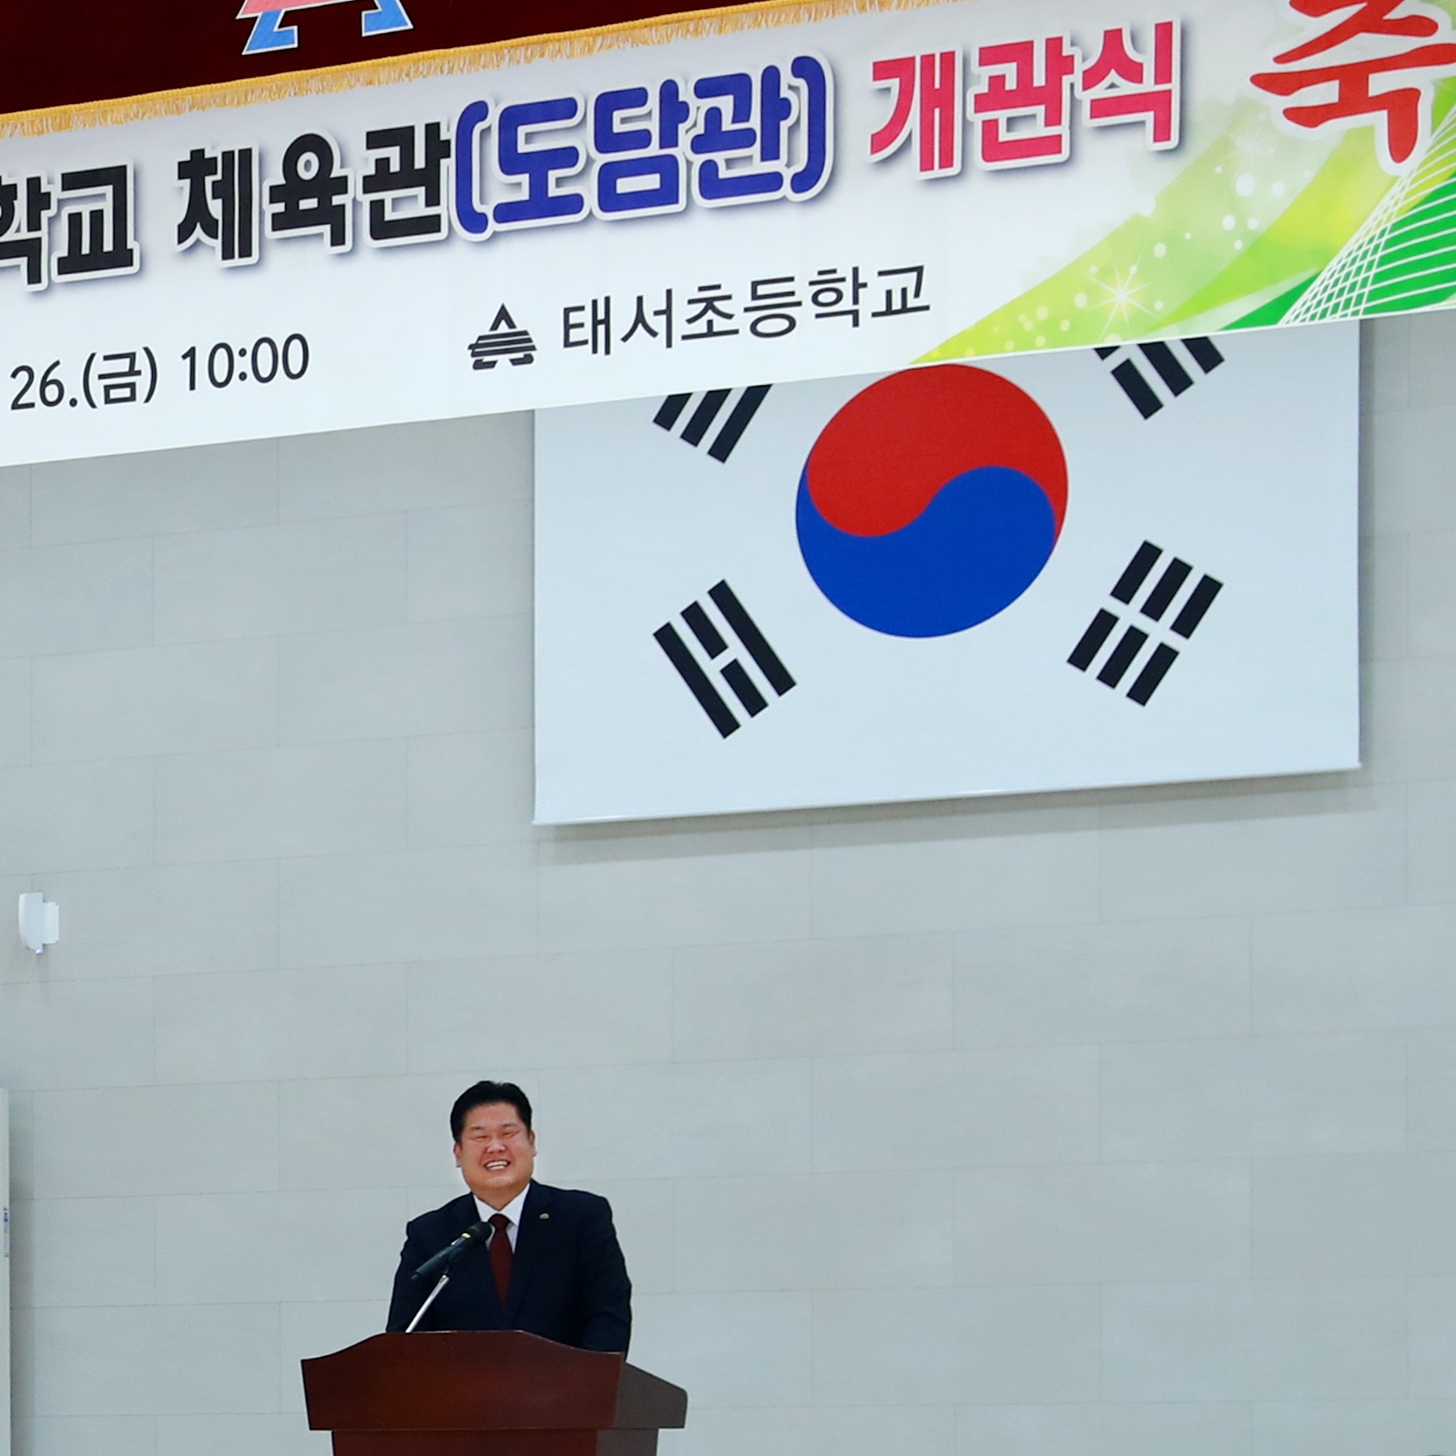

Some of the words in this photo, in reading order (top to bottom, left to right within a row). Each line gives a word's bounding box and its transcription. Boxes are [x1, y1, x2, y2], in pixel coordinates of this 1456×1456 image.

[872, 22, 1172, 171] 개관식
[564, 266, 929, 354] 태서초등학교
[182, 334, 308, 390] 10:00
